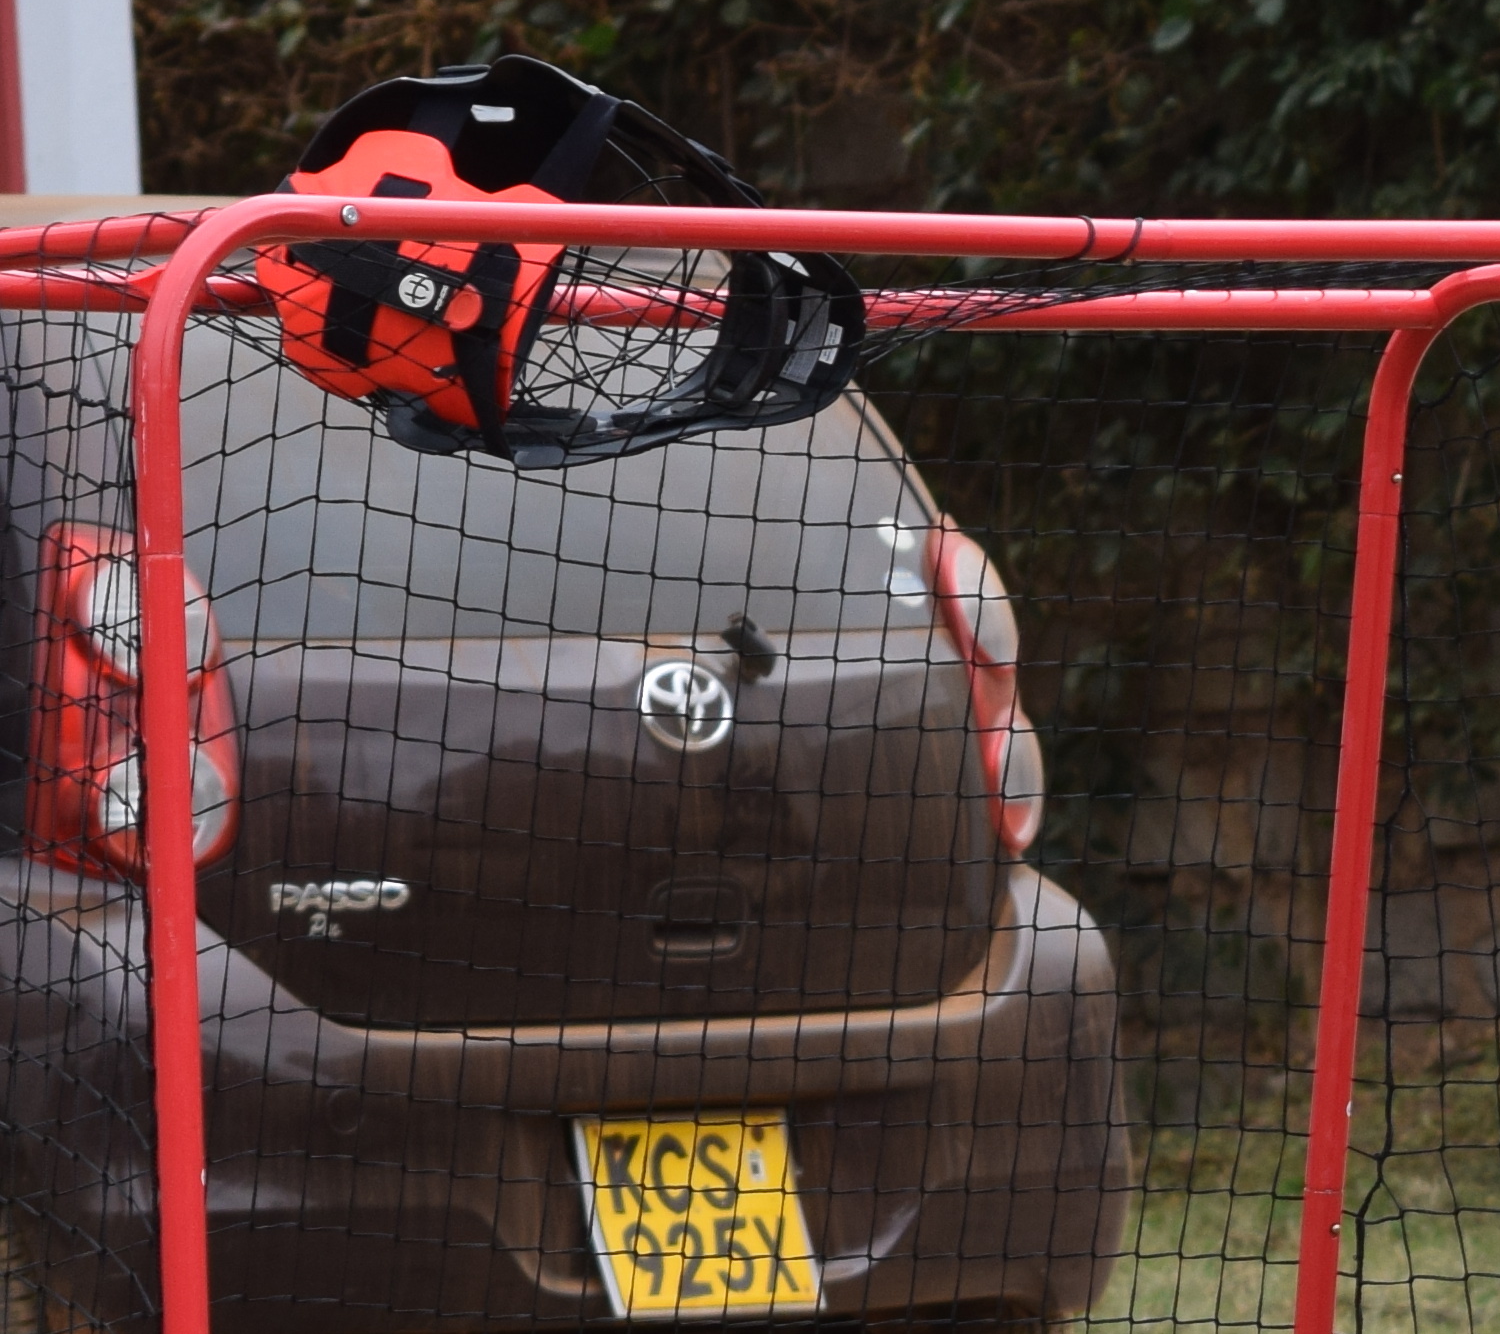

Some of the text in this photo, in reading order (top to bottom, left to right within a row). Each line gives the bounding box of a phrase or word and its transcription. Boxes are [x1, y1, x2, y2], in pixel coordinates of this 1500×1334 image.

[270, 878, 410, 913] PASSO
[602, 1132, 739, 1215] KCS
[623, 1216, 800, 1299] 925X
